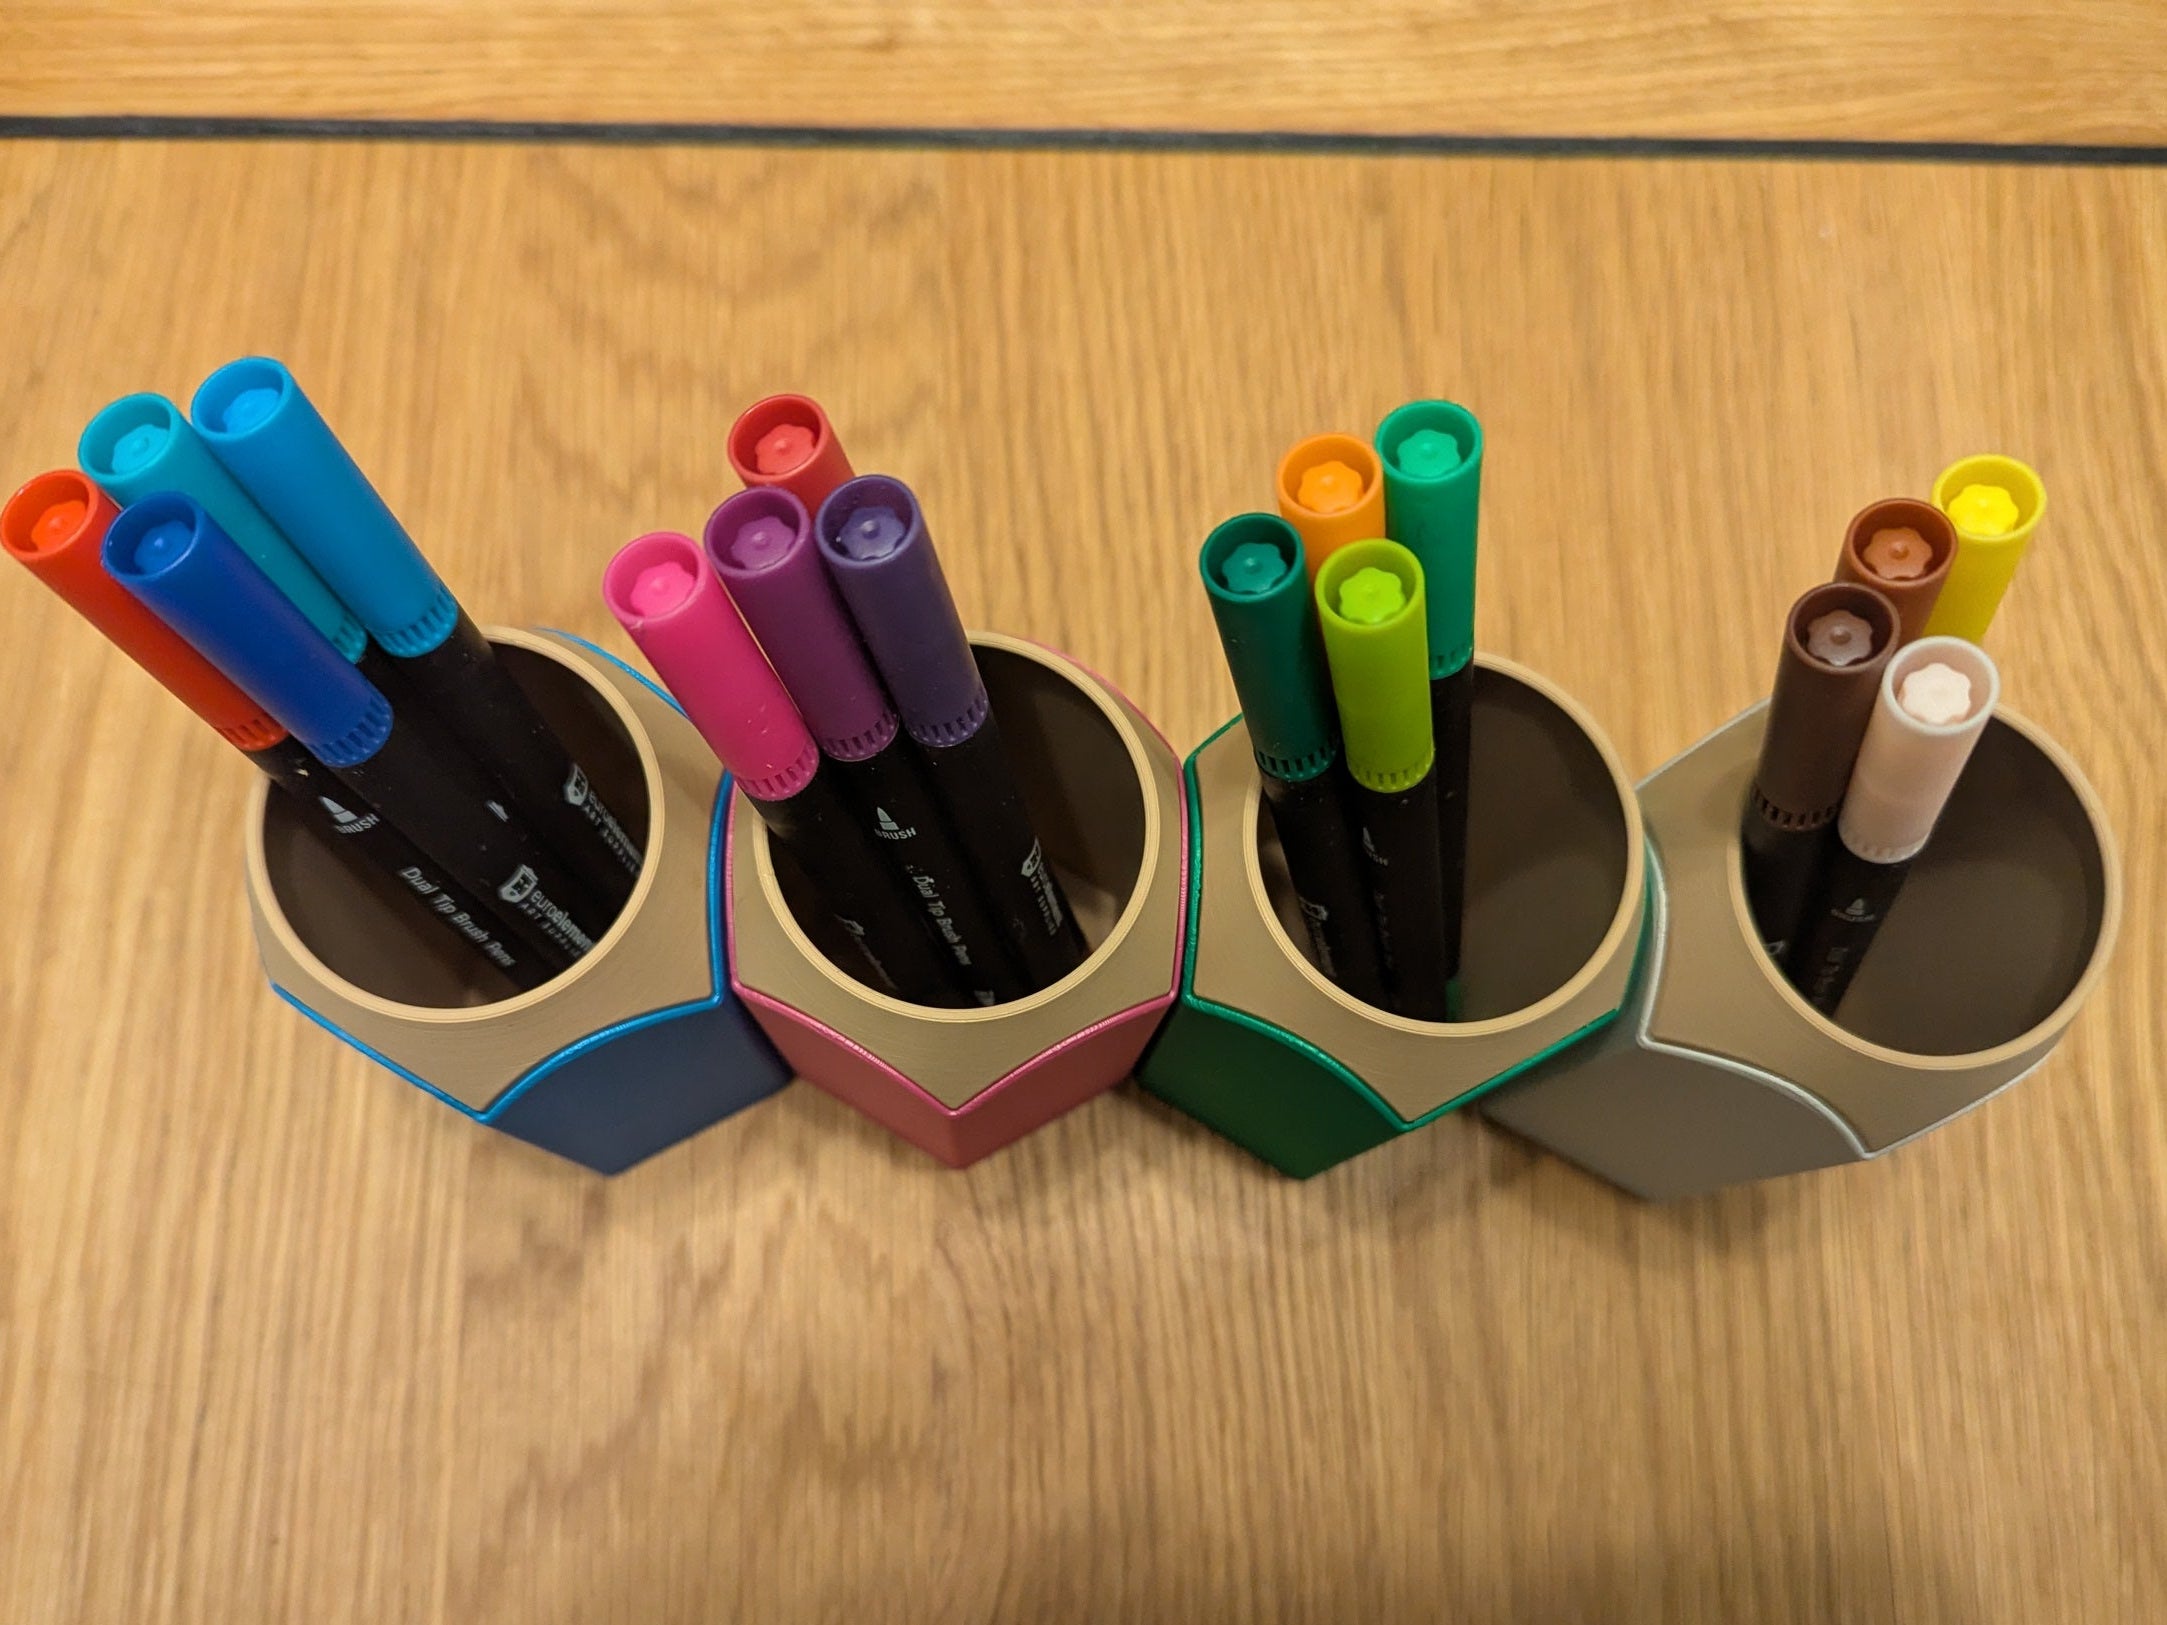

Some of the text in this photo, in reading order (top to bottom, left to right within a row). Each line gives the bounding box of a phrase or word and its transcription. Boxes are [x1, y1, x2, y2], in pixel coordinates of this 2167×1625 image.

[400, 867, 516, 967] Dual Tip Brush Pens
[912, 875, 940, 898] Dual
[928, 900, 946, 917] Tip
